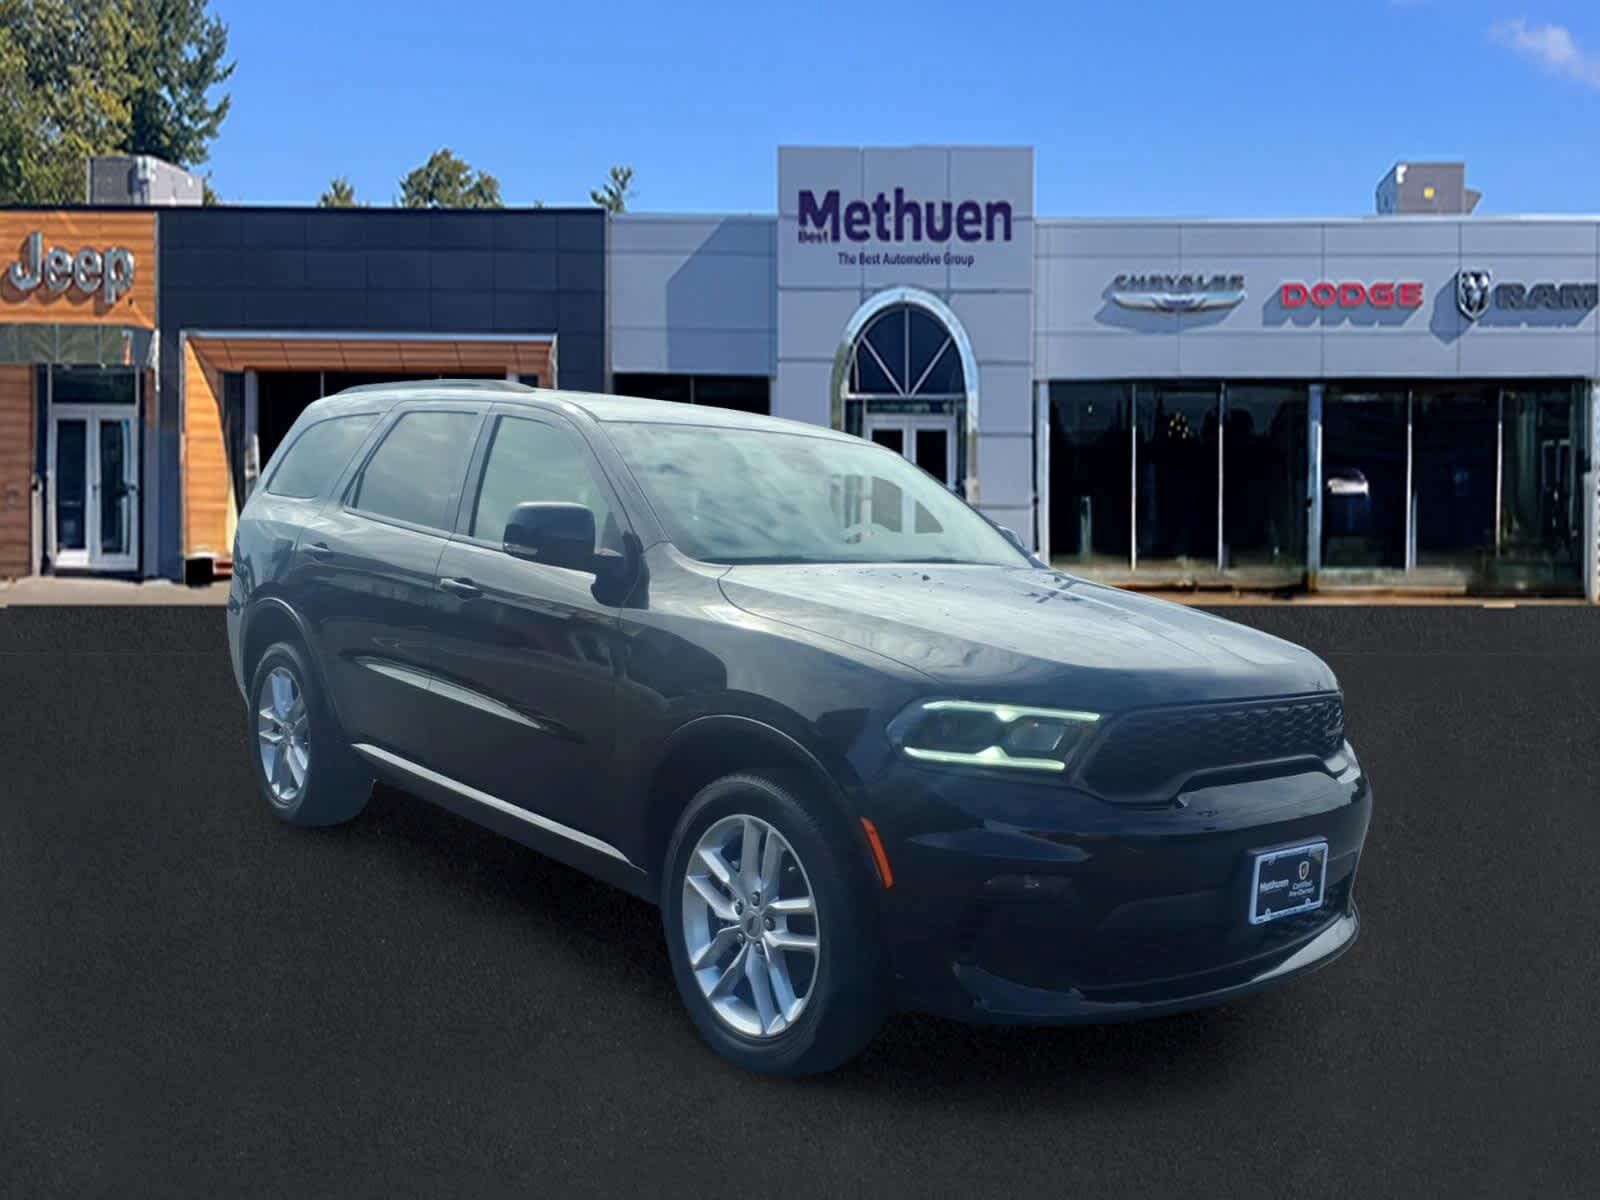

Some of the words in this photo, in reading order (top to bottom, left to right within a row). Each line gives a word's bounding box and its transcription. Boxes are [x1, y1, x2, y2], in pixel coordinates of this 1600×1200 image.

[798, 187, 1011, 242] Methuen
[9, 231, 135, 304] Jeep
[838, 252, 856, 265] The
[859, 252, 880, 265] Best
[883, 252, 941, 265] Automotive
[944, 252, 974, 268] Group
[1114, 274, 1245, 291] CHRYSLER
[1282, 282, 1424, 307] DODGE
[1496, 282, 1598, 310] RAM
